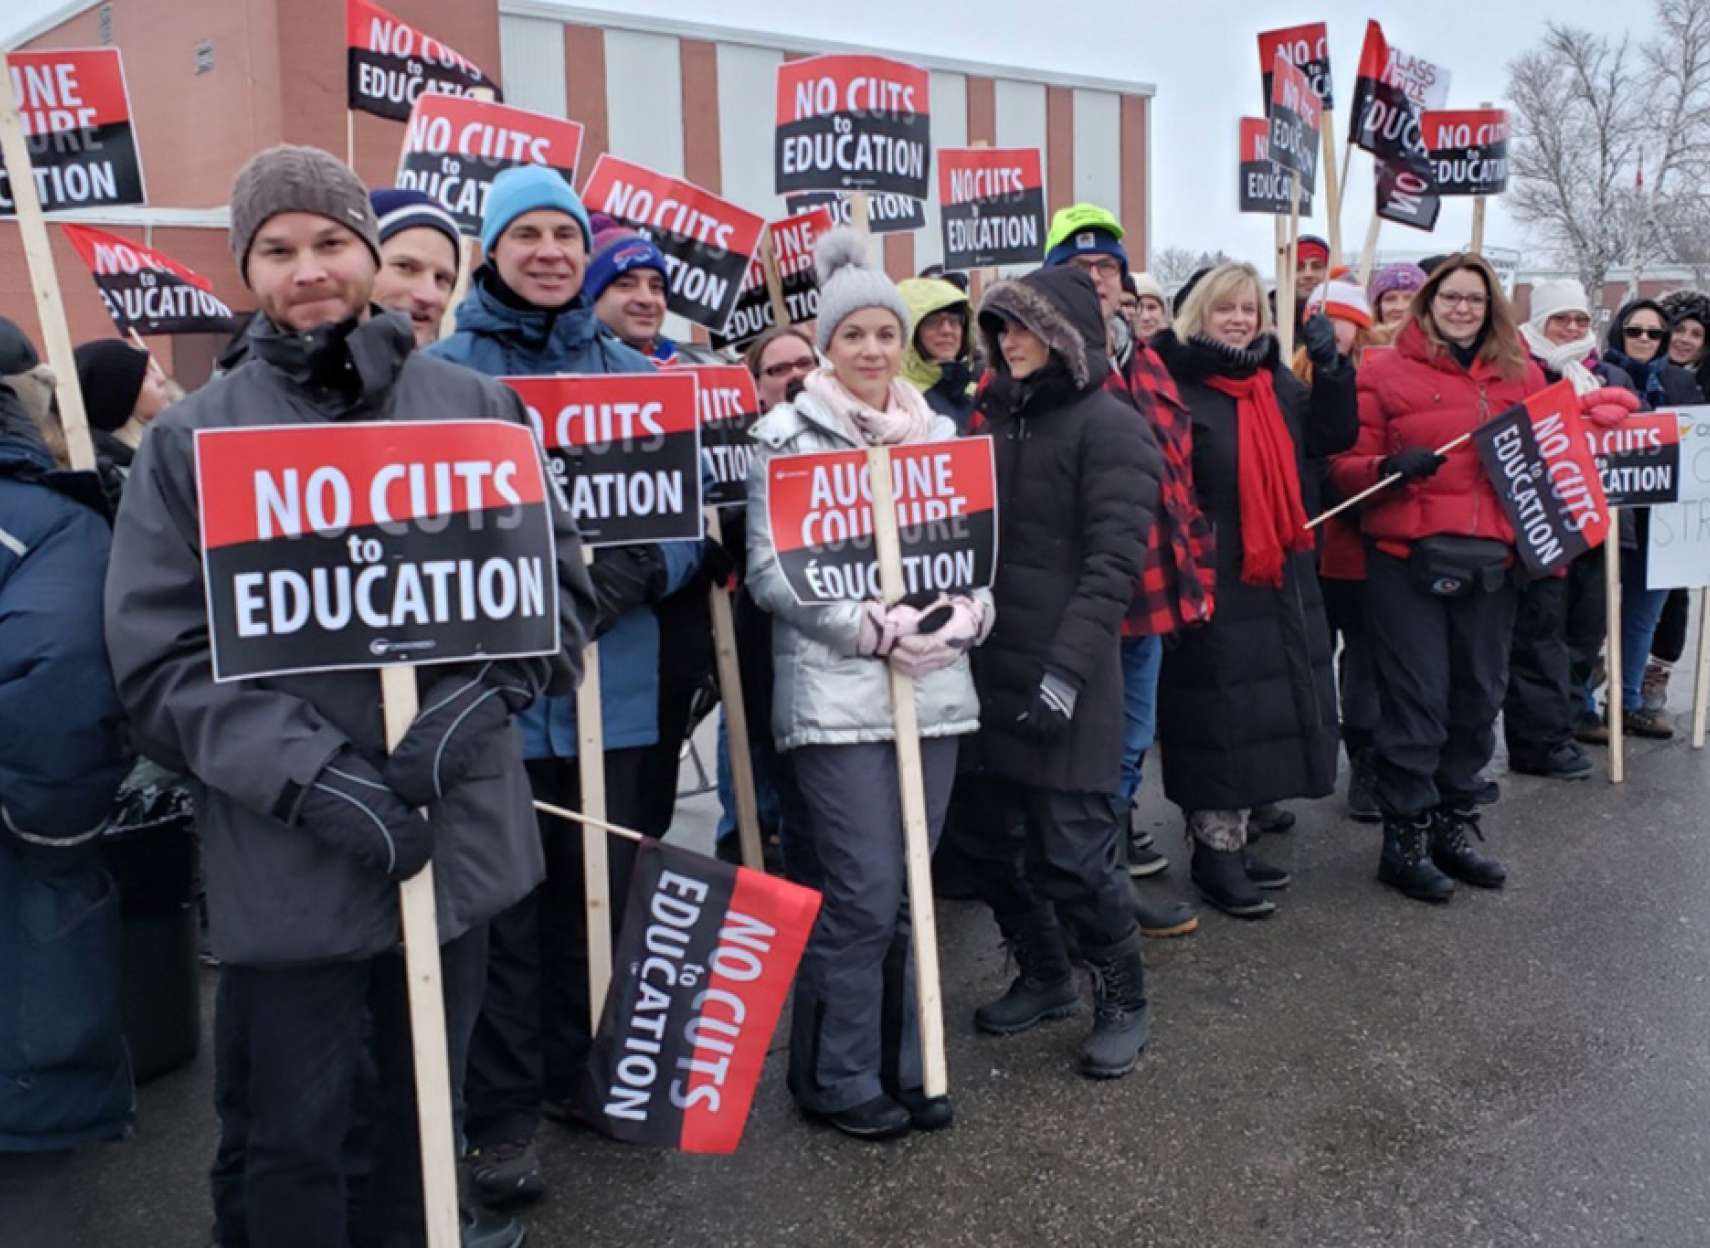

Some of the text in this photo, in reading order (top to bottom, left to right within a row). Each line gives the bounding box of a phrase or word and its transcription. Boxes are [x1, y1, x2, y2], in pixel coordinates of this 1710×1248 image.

[370, 16, 413, 58] NO
[407, 59, 423, 74] to
[1389, 46, 1437, 86] LASS
[795, 76, 916, 126] NO CUTS
[833, 114, 854, 134] to
[405, 114, 552, 168] NO CUTS
[783, 132, 924, 180] EDUCATION
[1437, 123, 1471, 149] NO
[442, 156, 461, 175] to
[950, 167, 1025, 204] NO CUTS
[603, 180, 736, 260] NO CUTS
[93, 242, 140, 275] NO
[556, 401, 666, 456] CUTS
[1602, 426, 1664, 458] CUTS
[1492, 423, 1564, 567] EDUCATION
[1532, 411, 1602, 534] NO CUTS
[253, 459, 524, 540] NO CUTS
[347, 533, 383, 564] to
[801, 495, 972, 555] COUURE
[232, 555, 546, 638] EDUCATION
[804, 549, 975, 600] ÉDUCTION
[603, 869, 710, 1122] EDUCATION
[679, 963, 705, 987] to
[669, 909, 777, 1114] NO CUTS
